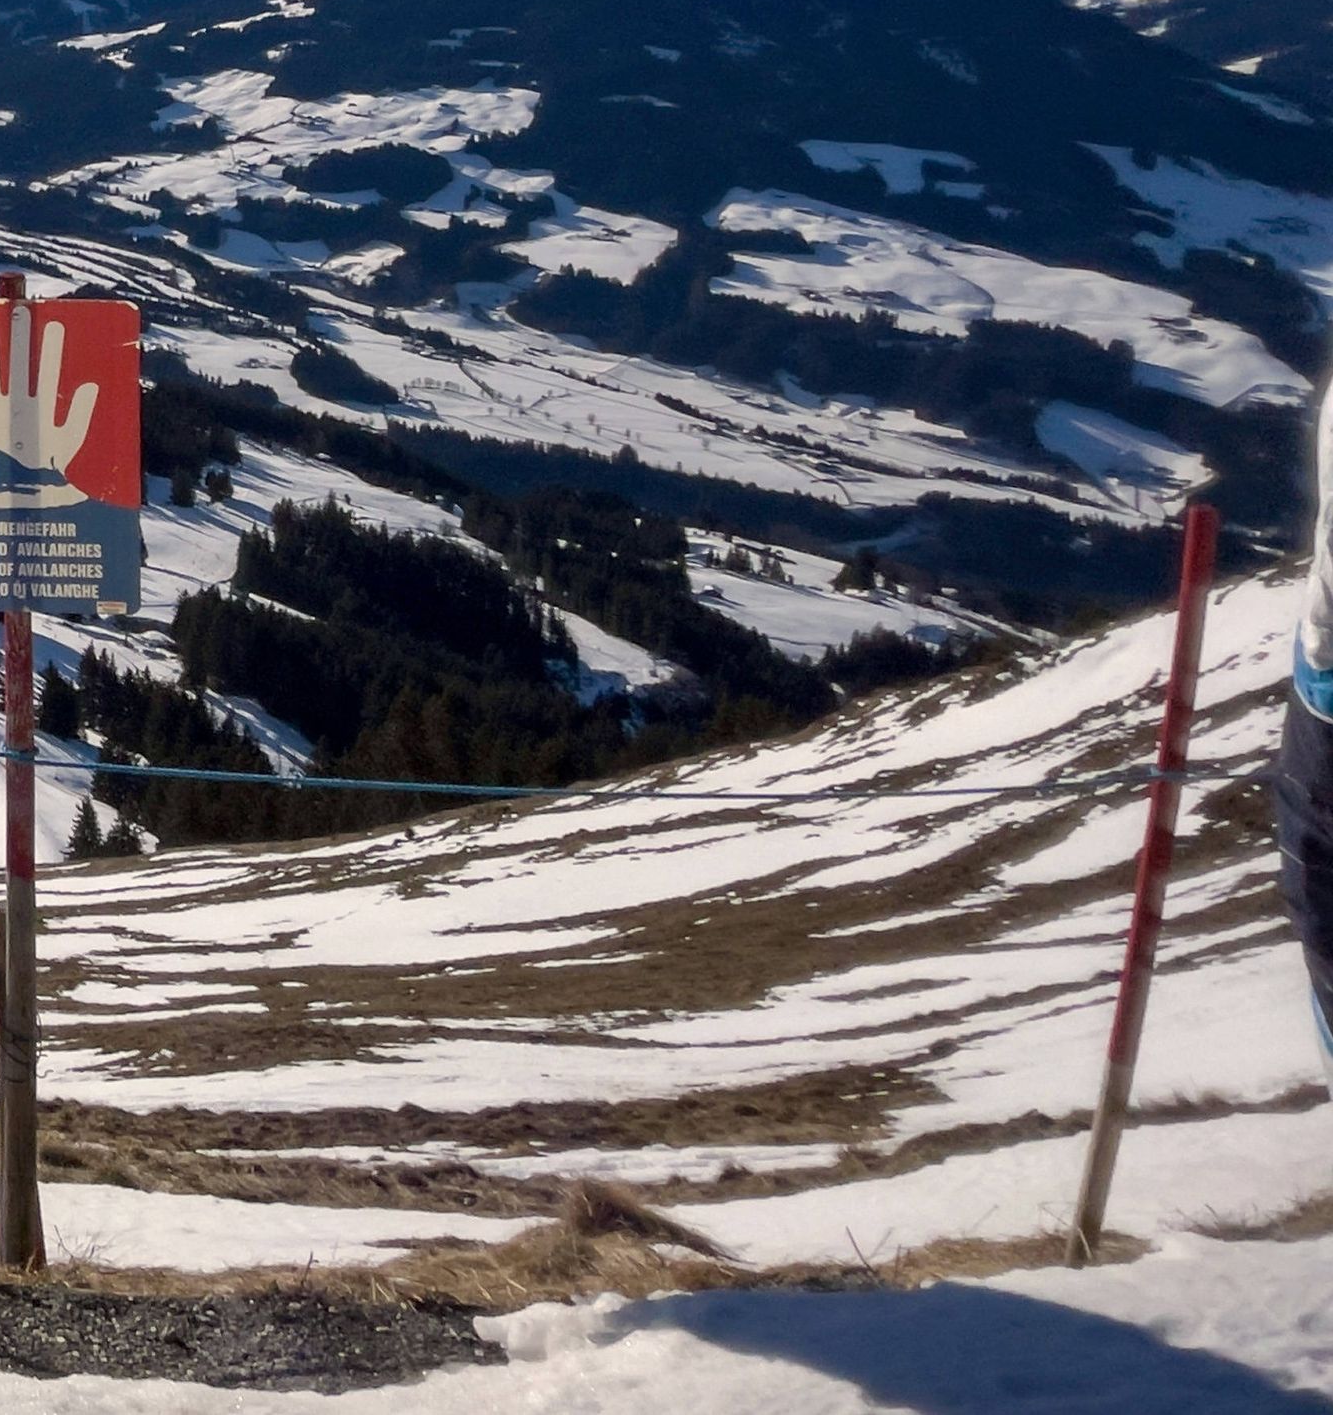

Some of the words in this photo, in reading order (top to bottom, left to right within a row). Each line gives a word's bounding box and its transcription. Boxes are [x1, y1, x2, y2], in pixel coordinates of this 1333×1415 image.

[17, 543, 102, 558] AVALANCHES
[18, 564, 103, 579] AVALANCHES
[30, 584, 99, 599] VALANGHE
